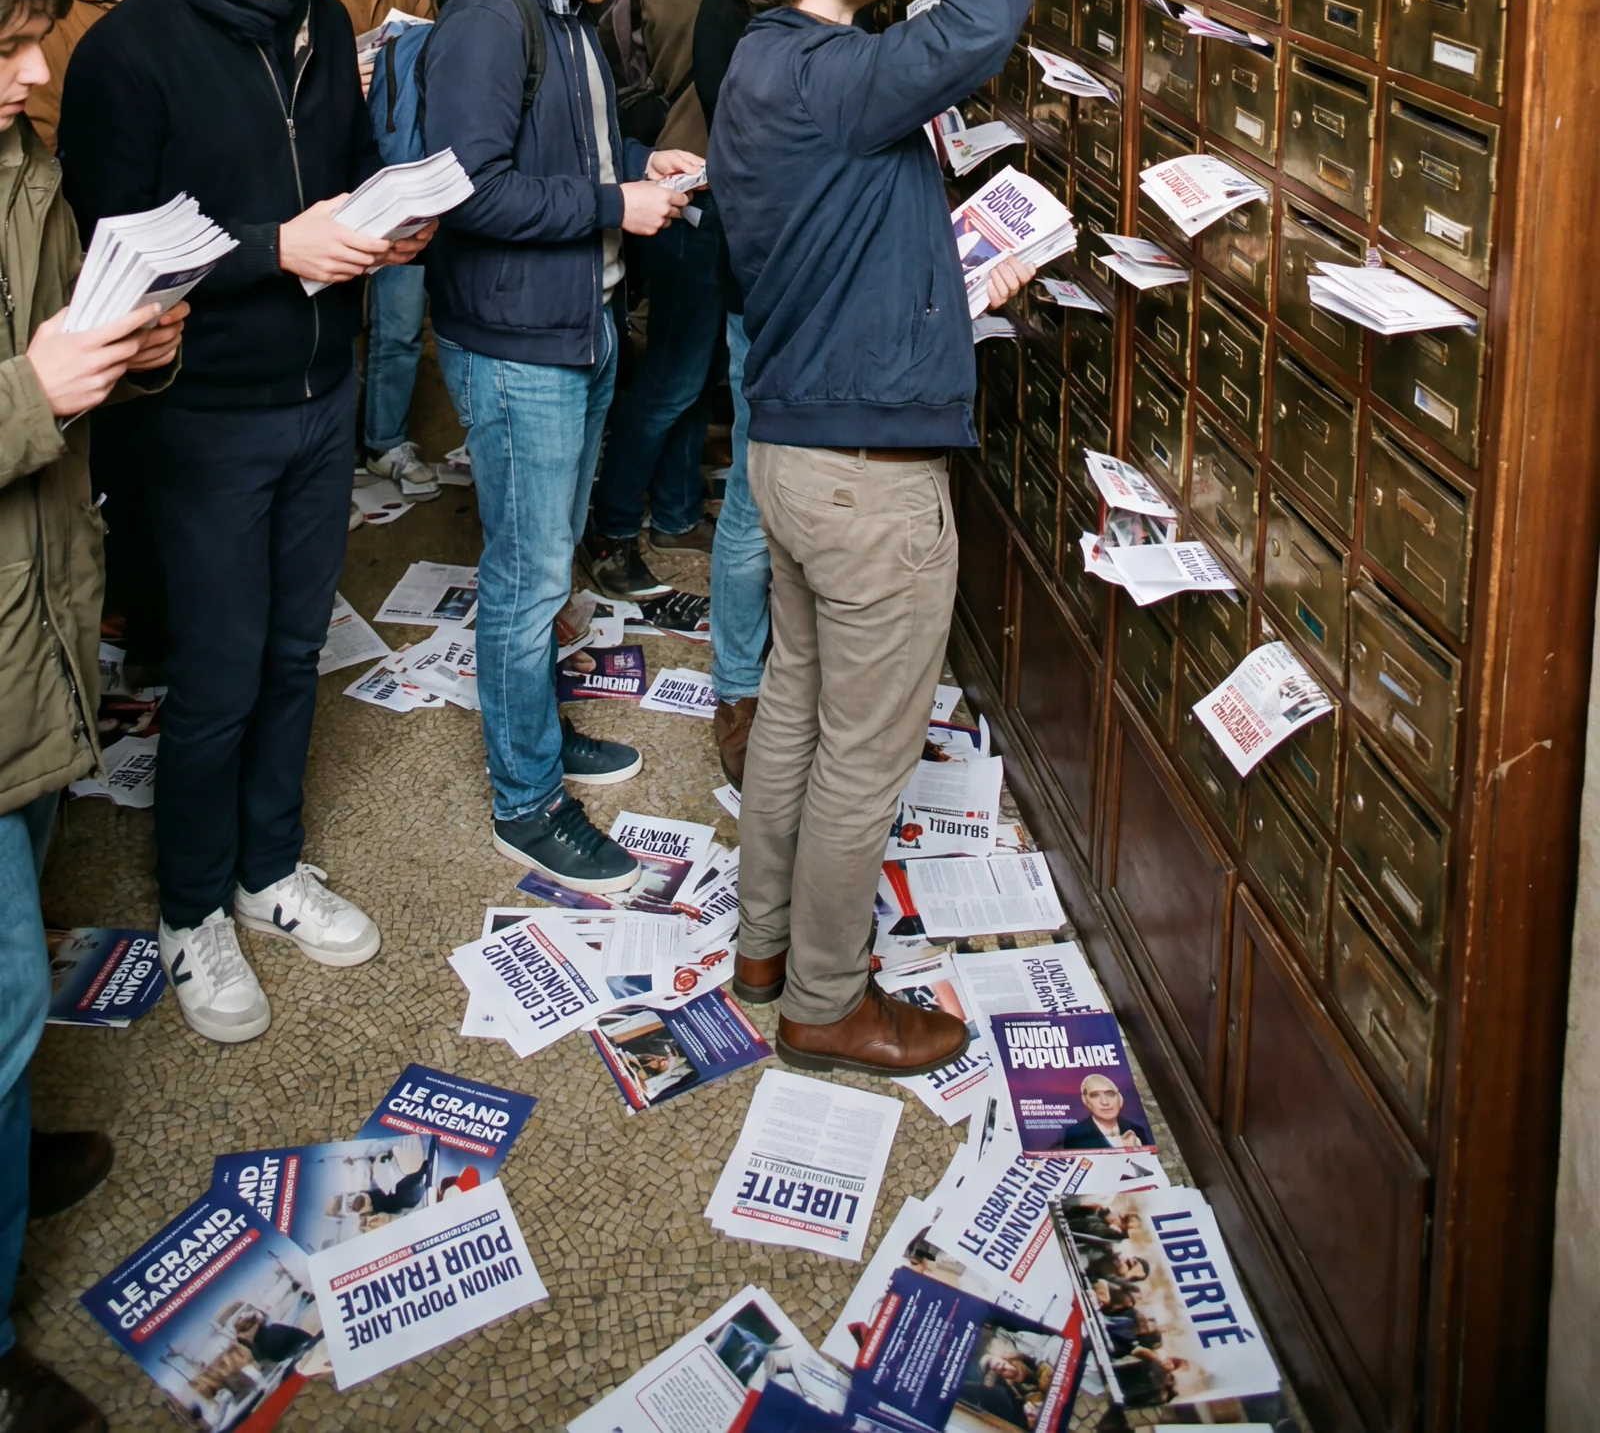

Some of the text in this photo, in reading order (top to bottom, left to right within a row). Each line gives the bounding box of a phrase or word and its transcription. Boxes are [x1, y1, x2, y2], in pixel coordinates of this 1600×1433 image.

[530, 1007, 560, 1030] LE
[1004, 1026, 1069, 1049] UNION
[1010, 1043, 1120, 1069] POPULAIRE
[388, 1098, 507, 1144] CHANGEMENT
[398, 1082, 511, 1128] LE GRAND
[107, 1279, 146, 1314] LE
[144, 1207, 233, 1285] GRAND
[119, 1213, 248, 1330] CHANGEMENT
[445, 1226, 512, 1273] POUR
[336, 1262, 442, 1323] FRANCE
[1151, 1209, 1256, 1349] LIBERTÉ
[347, 1256, 523, 1351] UNION POPULAIRE
